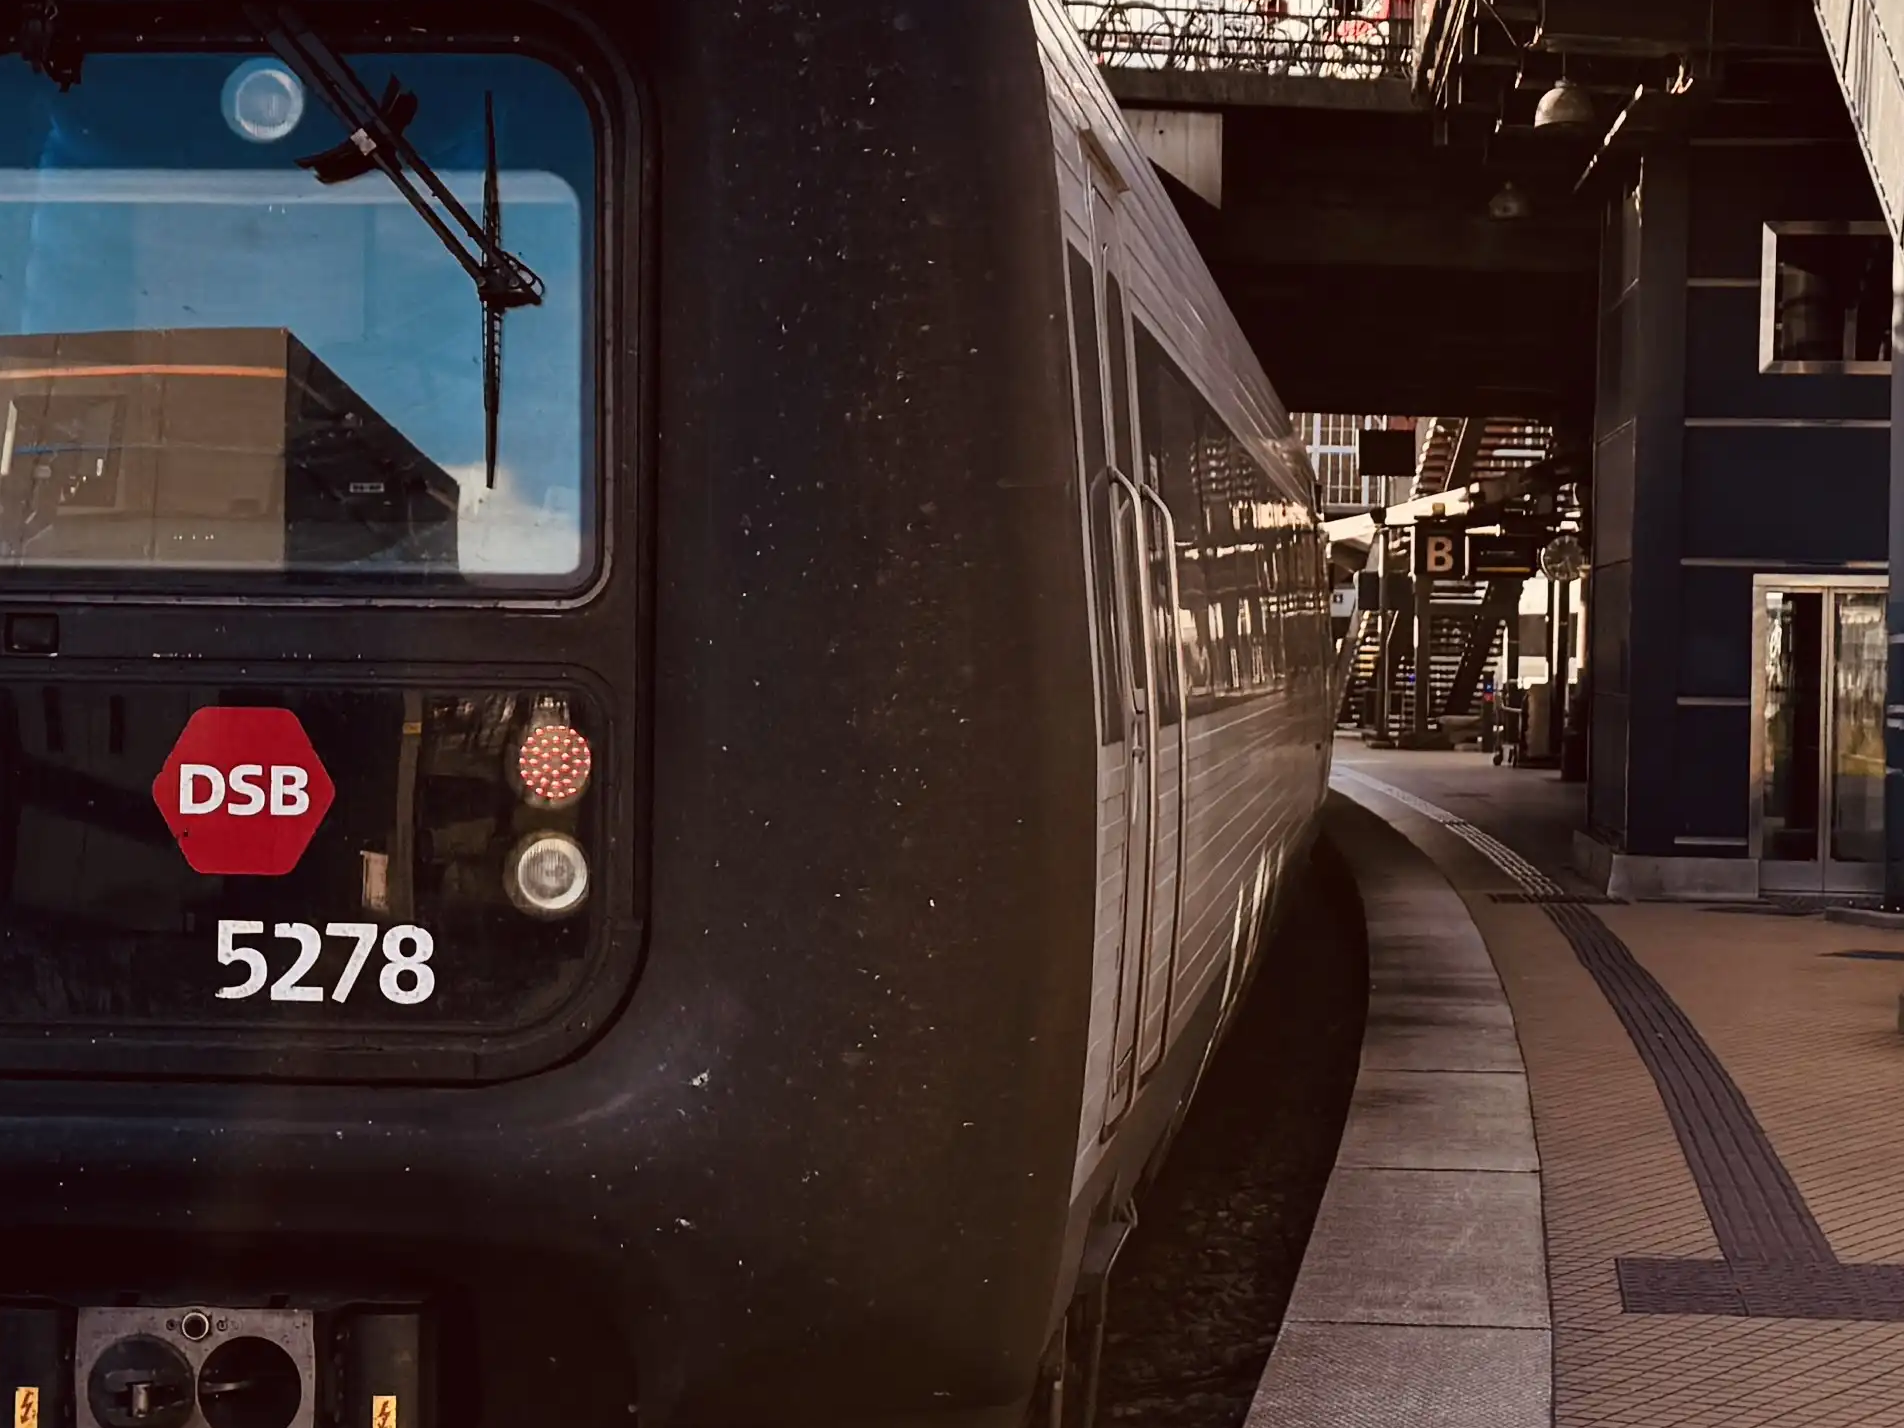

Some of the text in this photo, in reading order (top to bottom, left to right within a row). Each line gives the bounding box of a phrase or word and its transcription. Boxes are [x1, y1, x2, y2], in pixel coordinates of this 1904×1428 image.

[1426, 535, 1454, 573] B
[179, 763, 310, 816] DSB
[214, 919, 436, 1005] 5278
